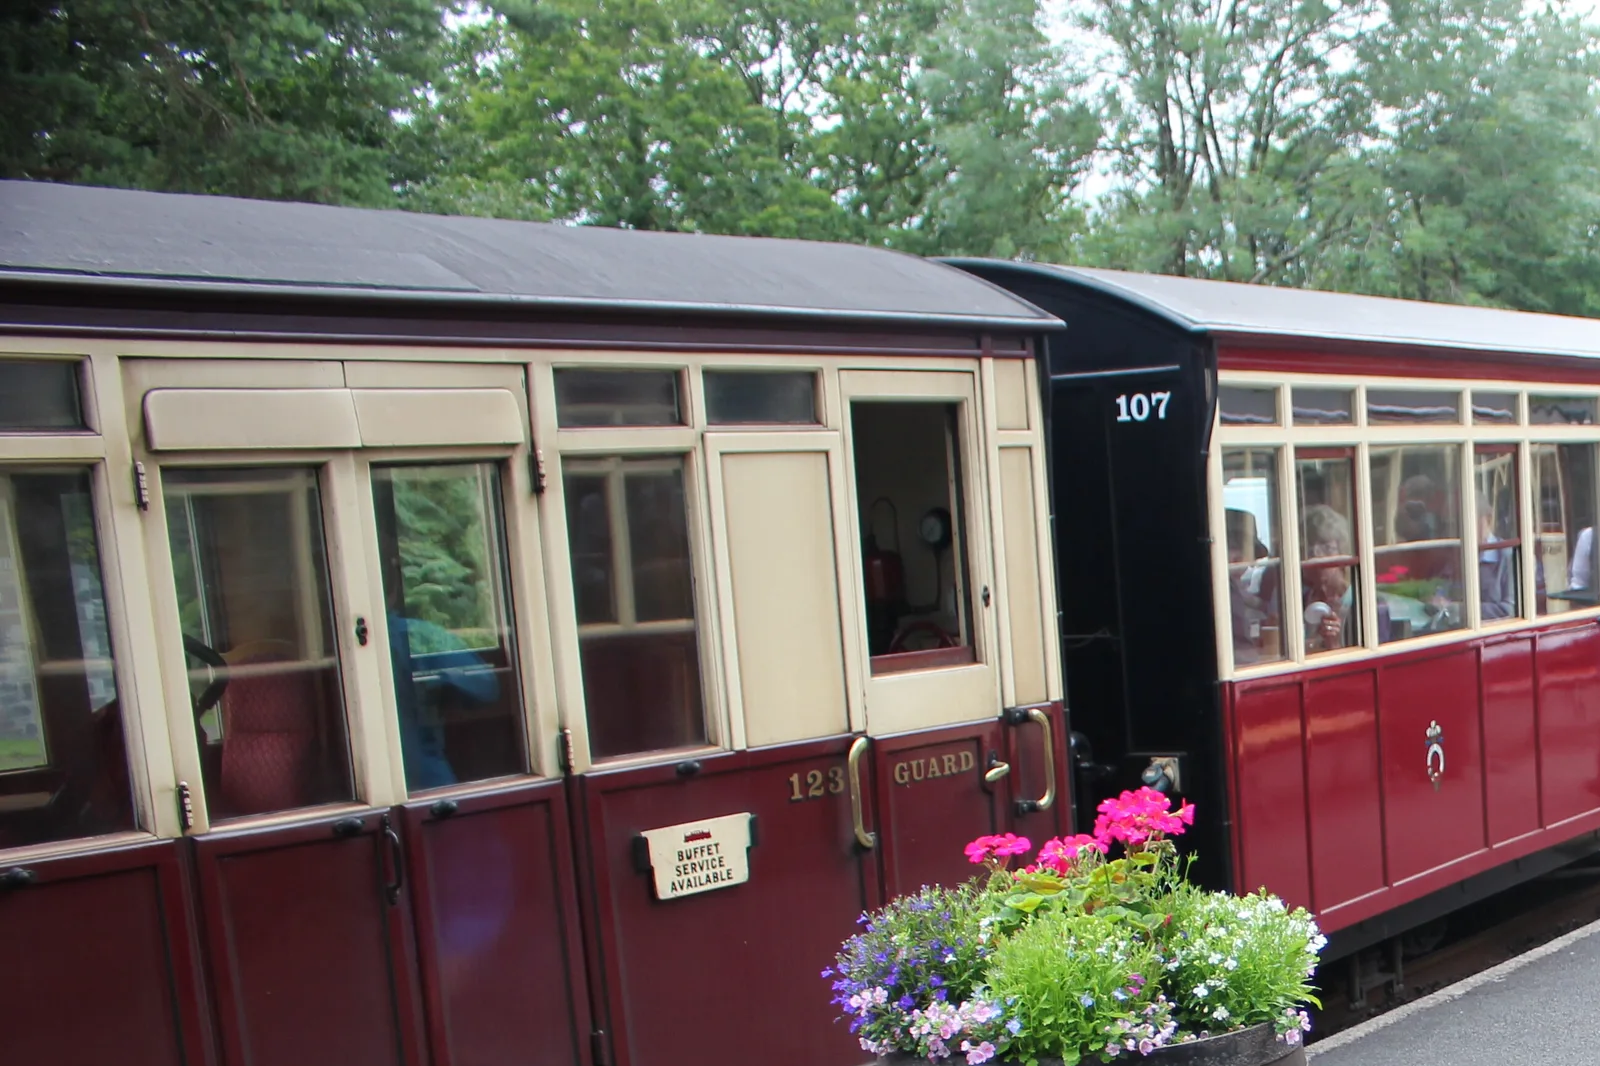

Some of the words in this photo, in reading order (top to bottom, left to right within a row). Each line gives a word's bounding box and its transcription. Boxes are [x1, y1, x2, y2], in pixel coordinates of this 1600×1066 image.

[1115, 390, 1171, 422] 107
[893, 751, 975, 784] GUARD
[788, 766, 845, 800] 123
[677, 842, 720, 862] BUFFET
[670, 868, 734, 893] AVAILABLE
[675, 856, 725, 877] SERVICE
